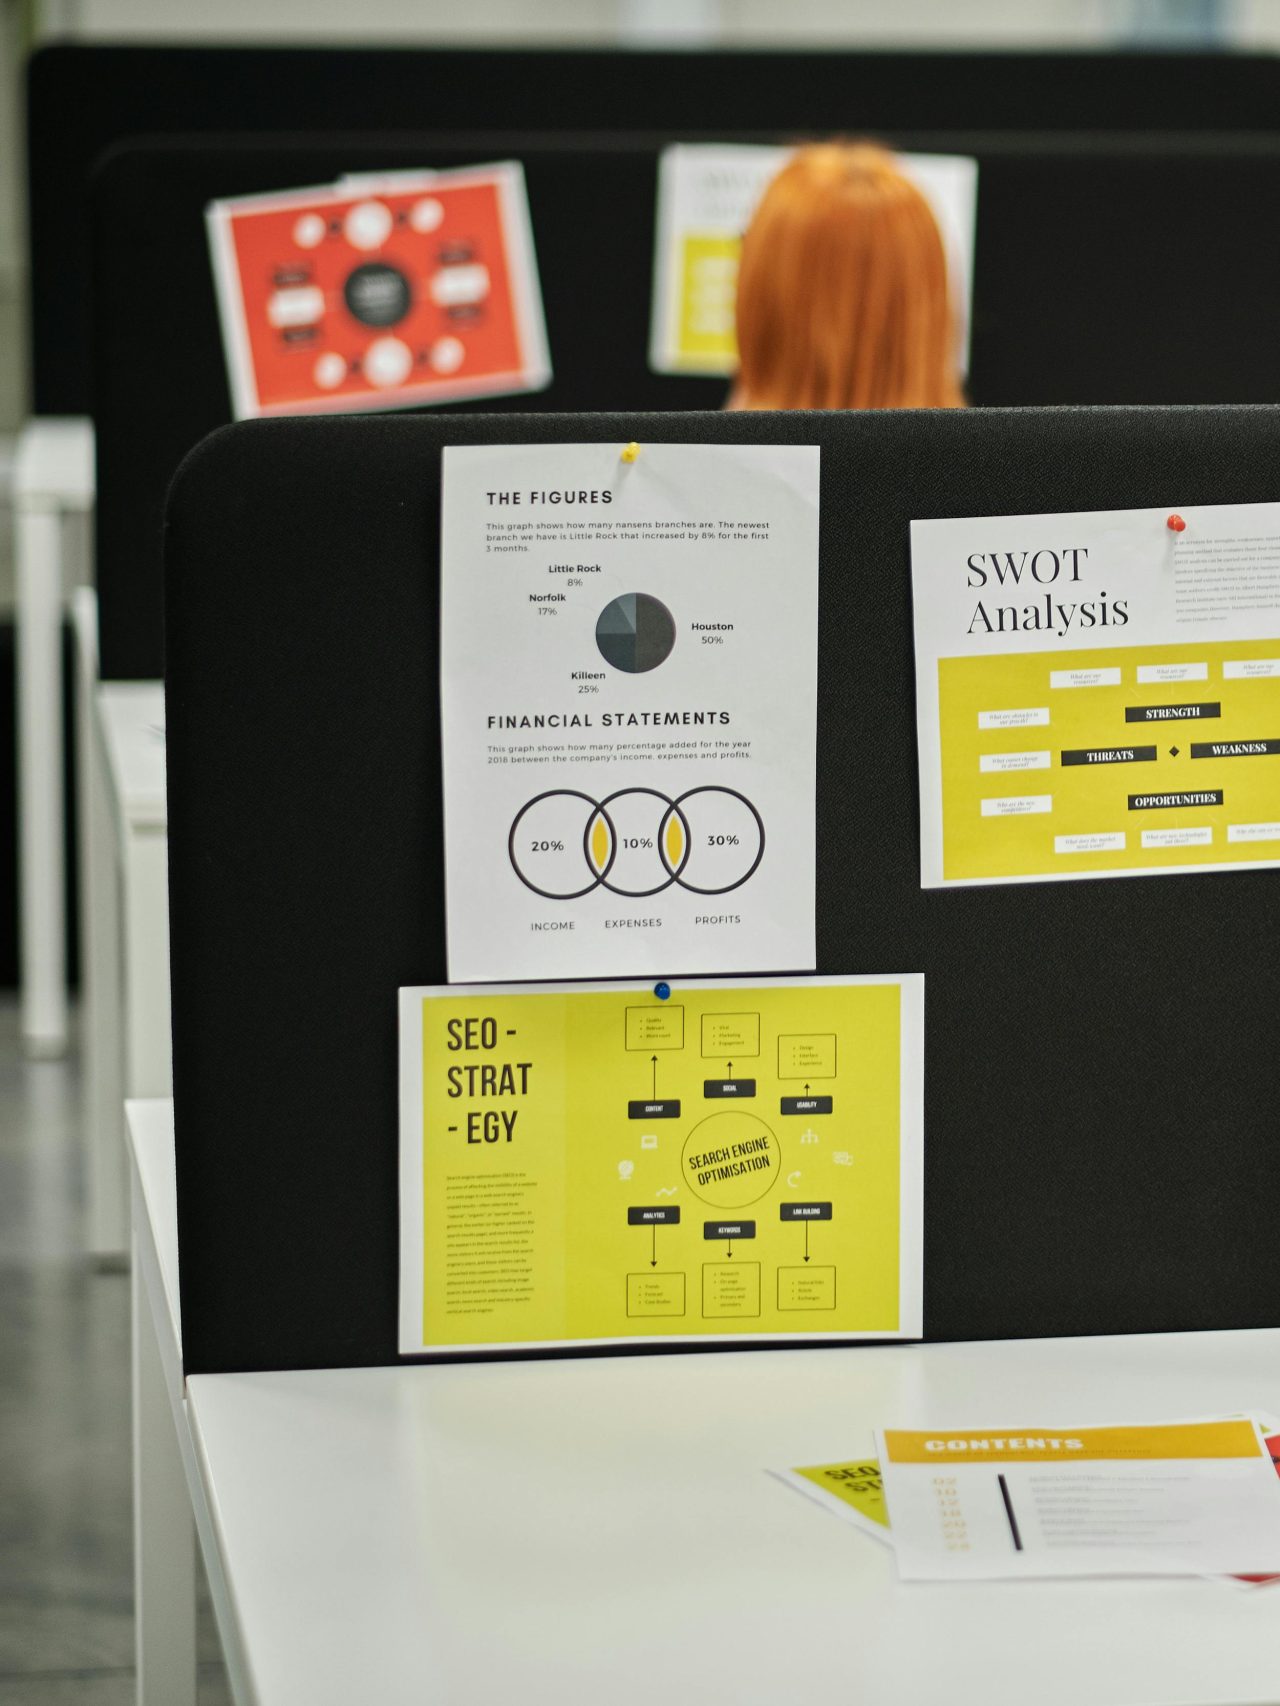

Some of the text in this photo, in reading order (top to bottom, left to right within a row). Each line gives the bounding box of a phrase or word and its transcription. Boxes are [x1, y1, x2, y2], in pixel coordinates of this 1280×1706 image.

[487, 490, 613, 505] THE FIGURES
[486, 522, 505, 530] This
[507, 521, 534, 531] graph
[536, 521, 564, 529] shows
[566, 521, 586, 529] how
[588, 521, 613, 531] many
[655, 520, 696, 529] branches
[718, 520, 735, 528] The
[486, 533, 518, 542] branch
[536, 533, 557, 541] have
[569, 532, 593, 540] Little
[595, 532, 618, 540] Rock
[620, 532, 640, 540] that
[642, 532, 685, 540] increased
[688, 532, 699, 541] by
[701, 532, 716, 540] 8%
[718, 532, 731, 540] for
[733, 532, 749, 540] the
[751, 531, 769, 540] first
[548, 564, 602, 574] Little Rock
[966, 548, 1089, 588] SWOT
[567, 578, 583, 587] 8%
[529, 593, 566, 603] Norfolk
[538, 607, 557, 616] 17%
[966, 591, 1130, 637] Analysis
[691, 622, 734, 631] Houston
[701, 635, 724, 645] 50%
[571, 670, 606, 680] Killeen
[578, 685, 599, 694] 25%
[1145, 706, 1200, 719] STRENGTH
[487, 711, 731, 729] FINANCIAL STATEMENTS
[487, 740, 751, 754] This graph shows how many percentage added for the year
[1086, 742, 1267, 762] THREATS WEAKNESS
[510, 755, 550, 763] between
[552, 755, 567, 763] the
[569, 753, 618, 764] company's
[657, 753, 698, 761] expenses
[700, 751, 718, 759] and
[1134, 791, 1217, 807] OPPORTUNITIES
[531, 835, 740, 852] 20% 10% 30%
[531, 915, 741, 931] INCOME EXPENSES PROFITS
[446, 1016, 498, 1051] SEO
[446, 1062, 533, 1098] STRAT
[796, 1101, 817, 1109] USABILITY
[466, 1110, 518, 1145] EGY
[688, 1136, 770, 1170] SEARCH ENGINE
[697, 1154, 770, 1186] OPTIMISATION
[643, 1211, 665, 1219] ANALYTICS
[803, 1207, 821, 1215] BUILDING
[718, 1226, 741, 1234] KEYWORDS
[924, 1438, 1084, 1451] CONTENTS
[824, 1466, 881, 1480] SEO
